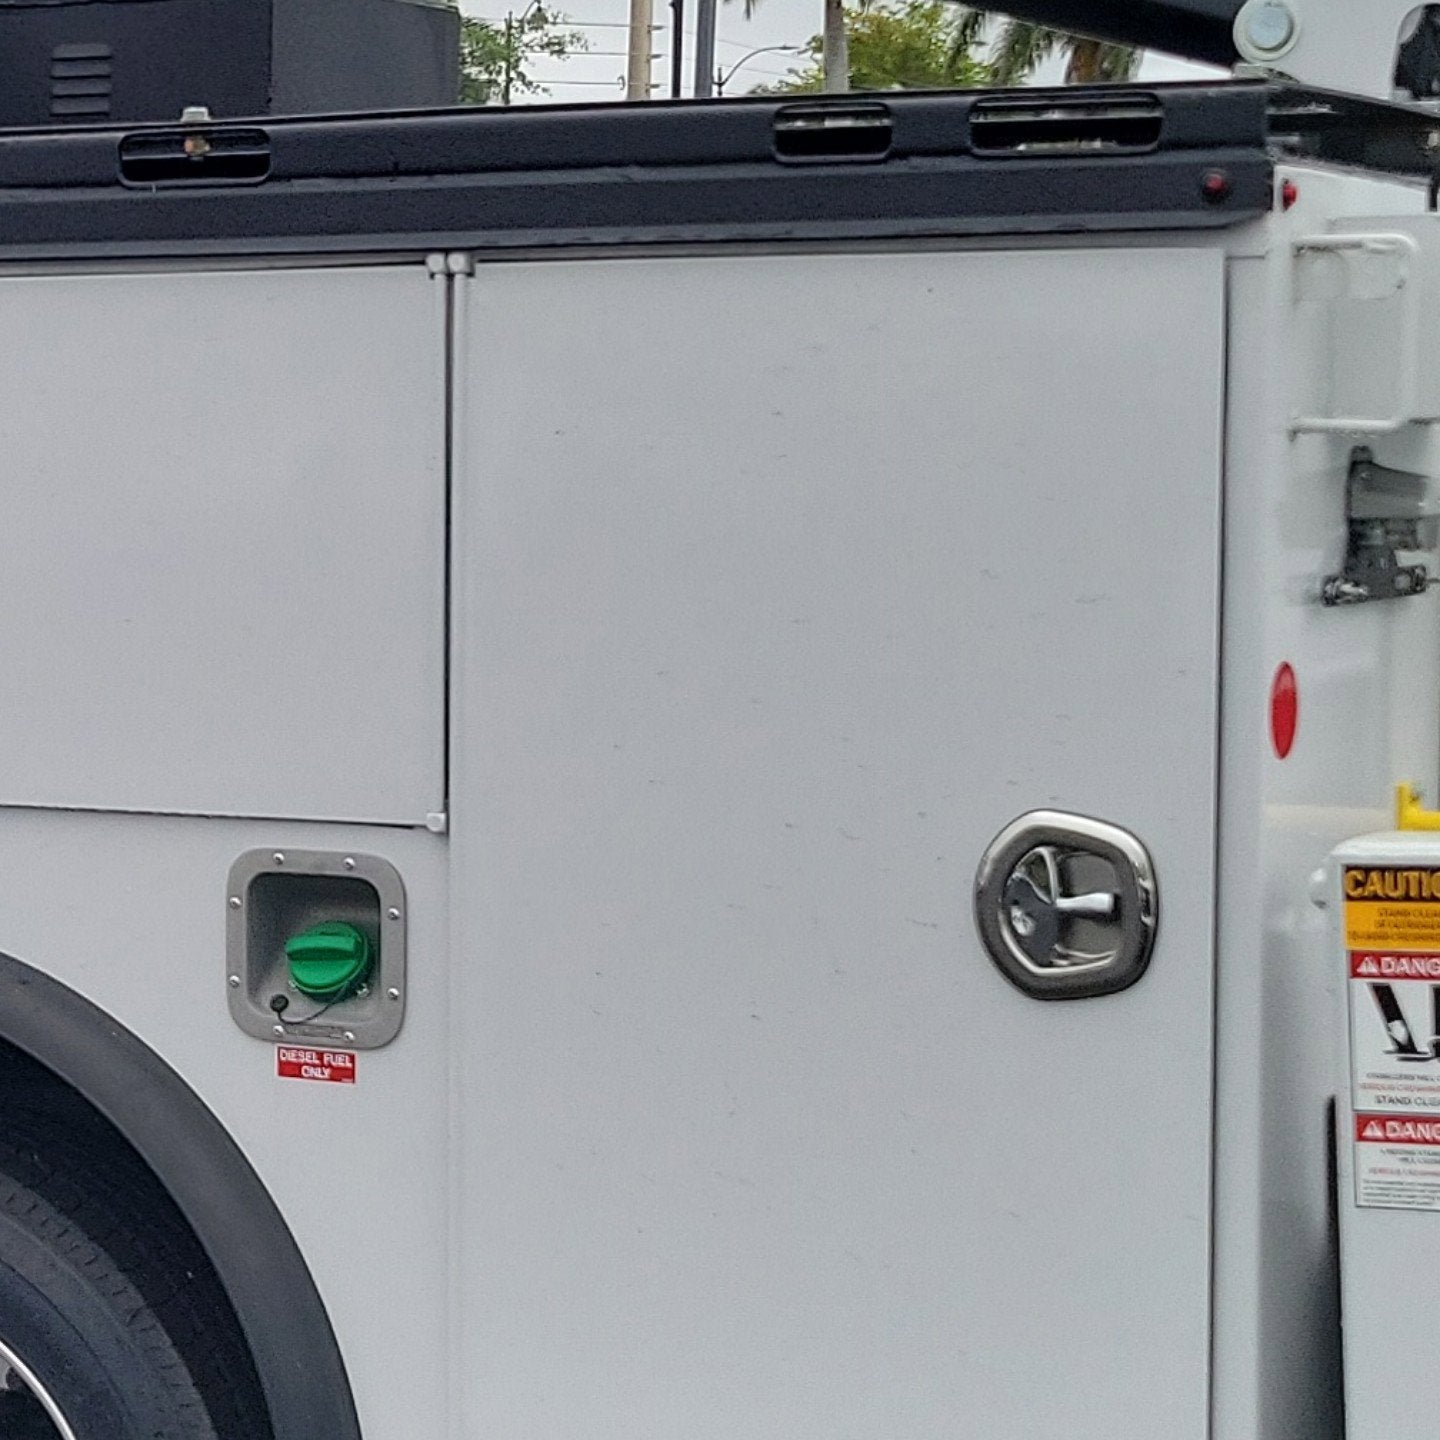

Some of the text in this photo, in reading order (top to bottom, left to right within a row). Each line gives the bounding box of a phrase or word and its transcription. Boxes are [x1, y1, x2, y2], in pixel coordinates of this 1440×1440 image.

[280, 1049, 353, 1068] DIESEL FUEL
[301, 1065, 331, 1079] ONLY
[1375, 1095, 1411, 1106] STAND
